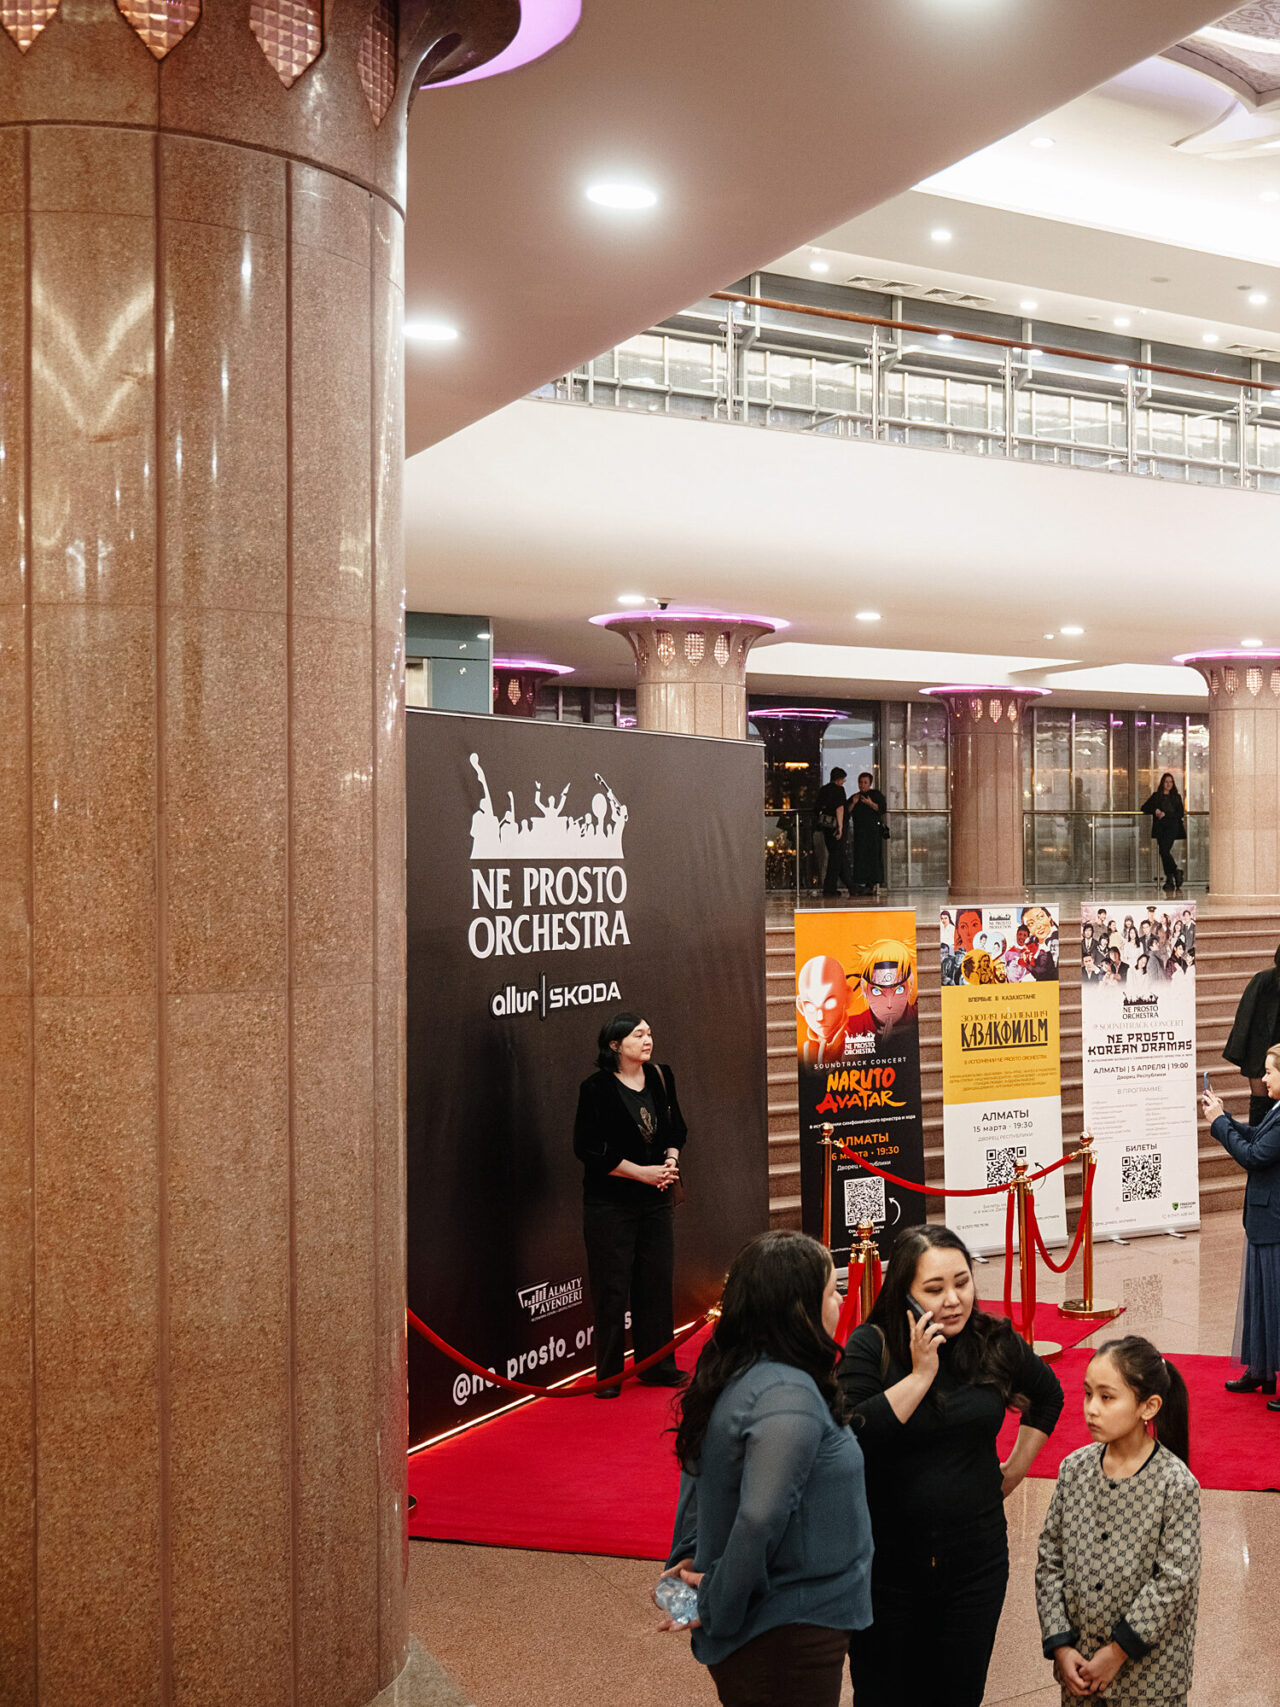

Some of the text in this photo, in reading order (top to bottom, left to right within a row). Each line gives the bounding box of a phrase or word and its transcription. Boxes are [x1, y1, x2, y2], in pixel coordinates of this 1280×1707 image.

[471, 865, 628, 910] NE PROSTO
[467, 910, 632, 960] ORCHESTRA
[492, 985, 539, 1017] allur
[1122, 1012, 1159, 1020] ORCHESTRA
[961, 1018, 1048, 1048] КАЗАКФИЛЬМ
[1107, 1031, 1175, 1044] NE PROSTO
[844, 1048, 876, 1056] ORCHESTRA
[1088, 1040, 1192, 1056] KOREAN DRAMAS
[814, 1056, 907, 1070] SOUNDTRACK CONCERT
[1093, 1066, 1126, 1074] АЛМАТЫ
[1137, 1064, 1166, 1072] АПРЕЛЯ
[826, 1066, 896, 1092] NARUTO
[816, 1090, 907, 1114] AVATAR
[982, 1109, 1029, 1122] АЛМАТЫ
[984, 1124, 1006, 1133] марта
[1014, 1121, 1033, 1129] 19:30
[838, 1132, 889, 1146] АЛМАТЫ
[876, 1146, 900, 1156] 19:30
[1126, 1144, 1158, 1152] БИЛЕТЫ
[548, 1276, 582, 1299] ALMATY
